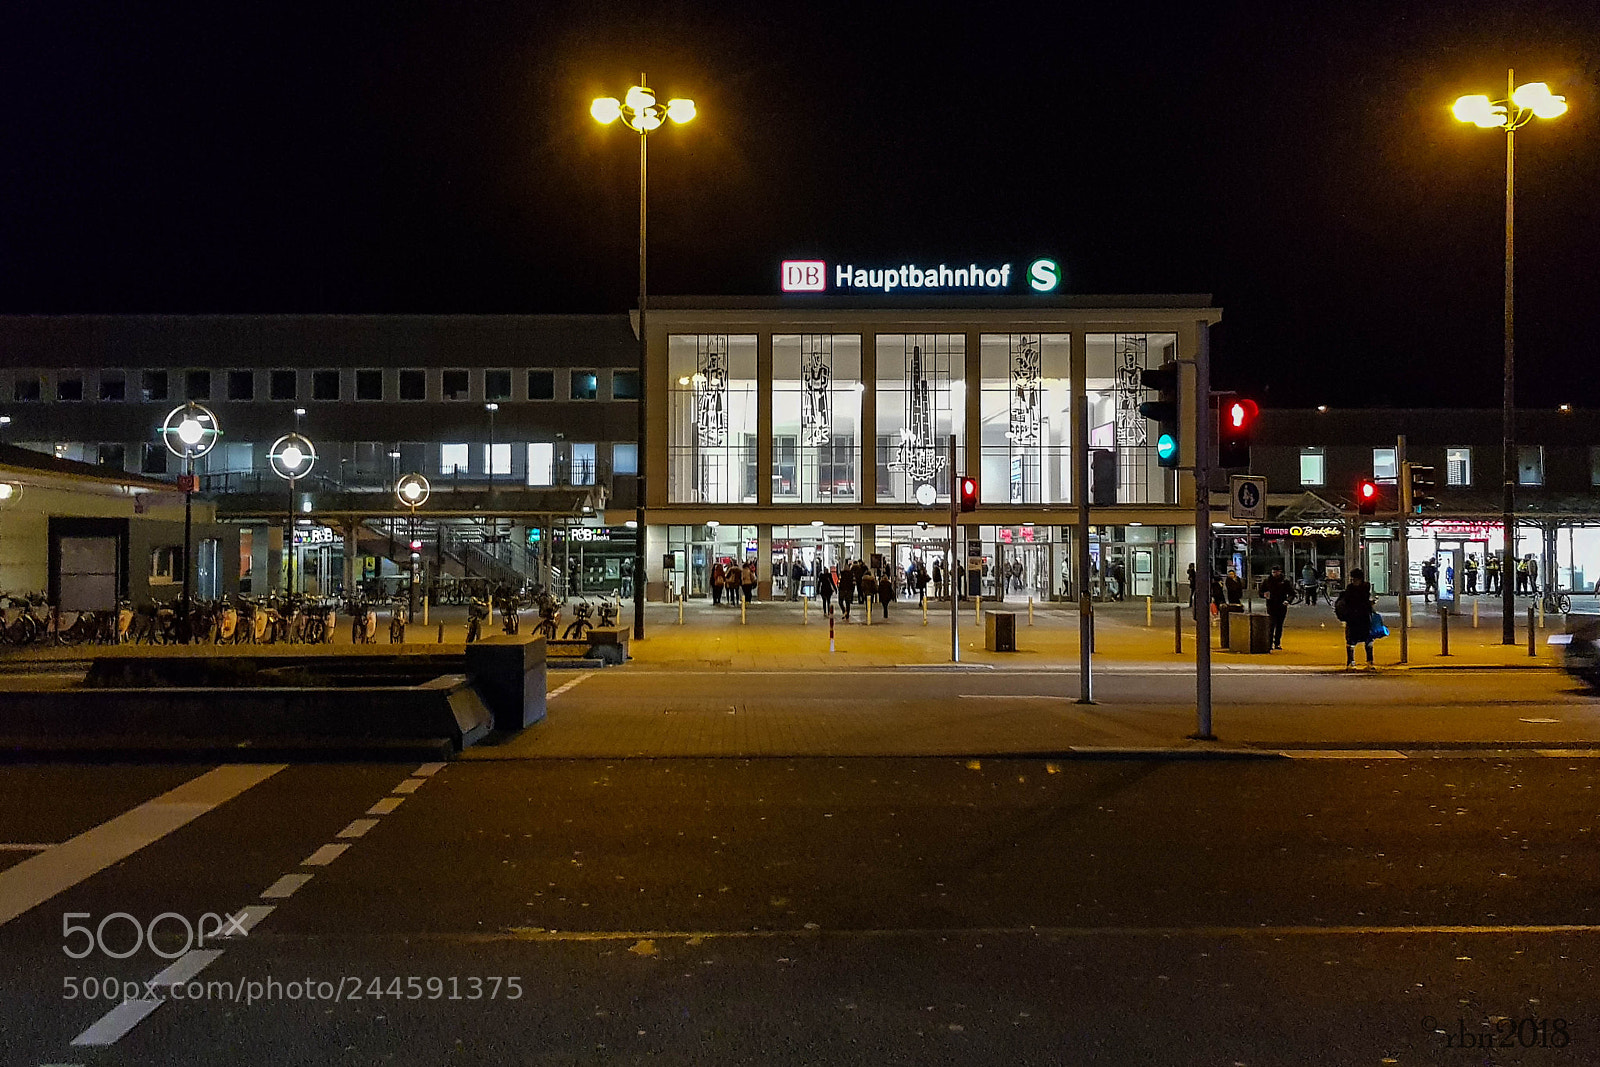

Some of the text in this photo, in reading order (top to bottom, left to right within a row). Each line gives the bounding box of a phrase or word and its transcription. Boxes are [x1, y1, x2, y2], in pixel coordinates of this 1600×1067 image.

[786, 264, 822, 287] DB
[835, 264, 1010, 292] Hauptbahnhof
[1030, 259, 1058, 291] S
